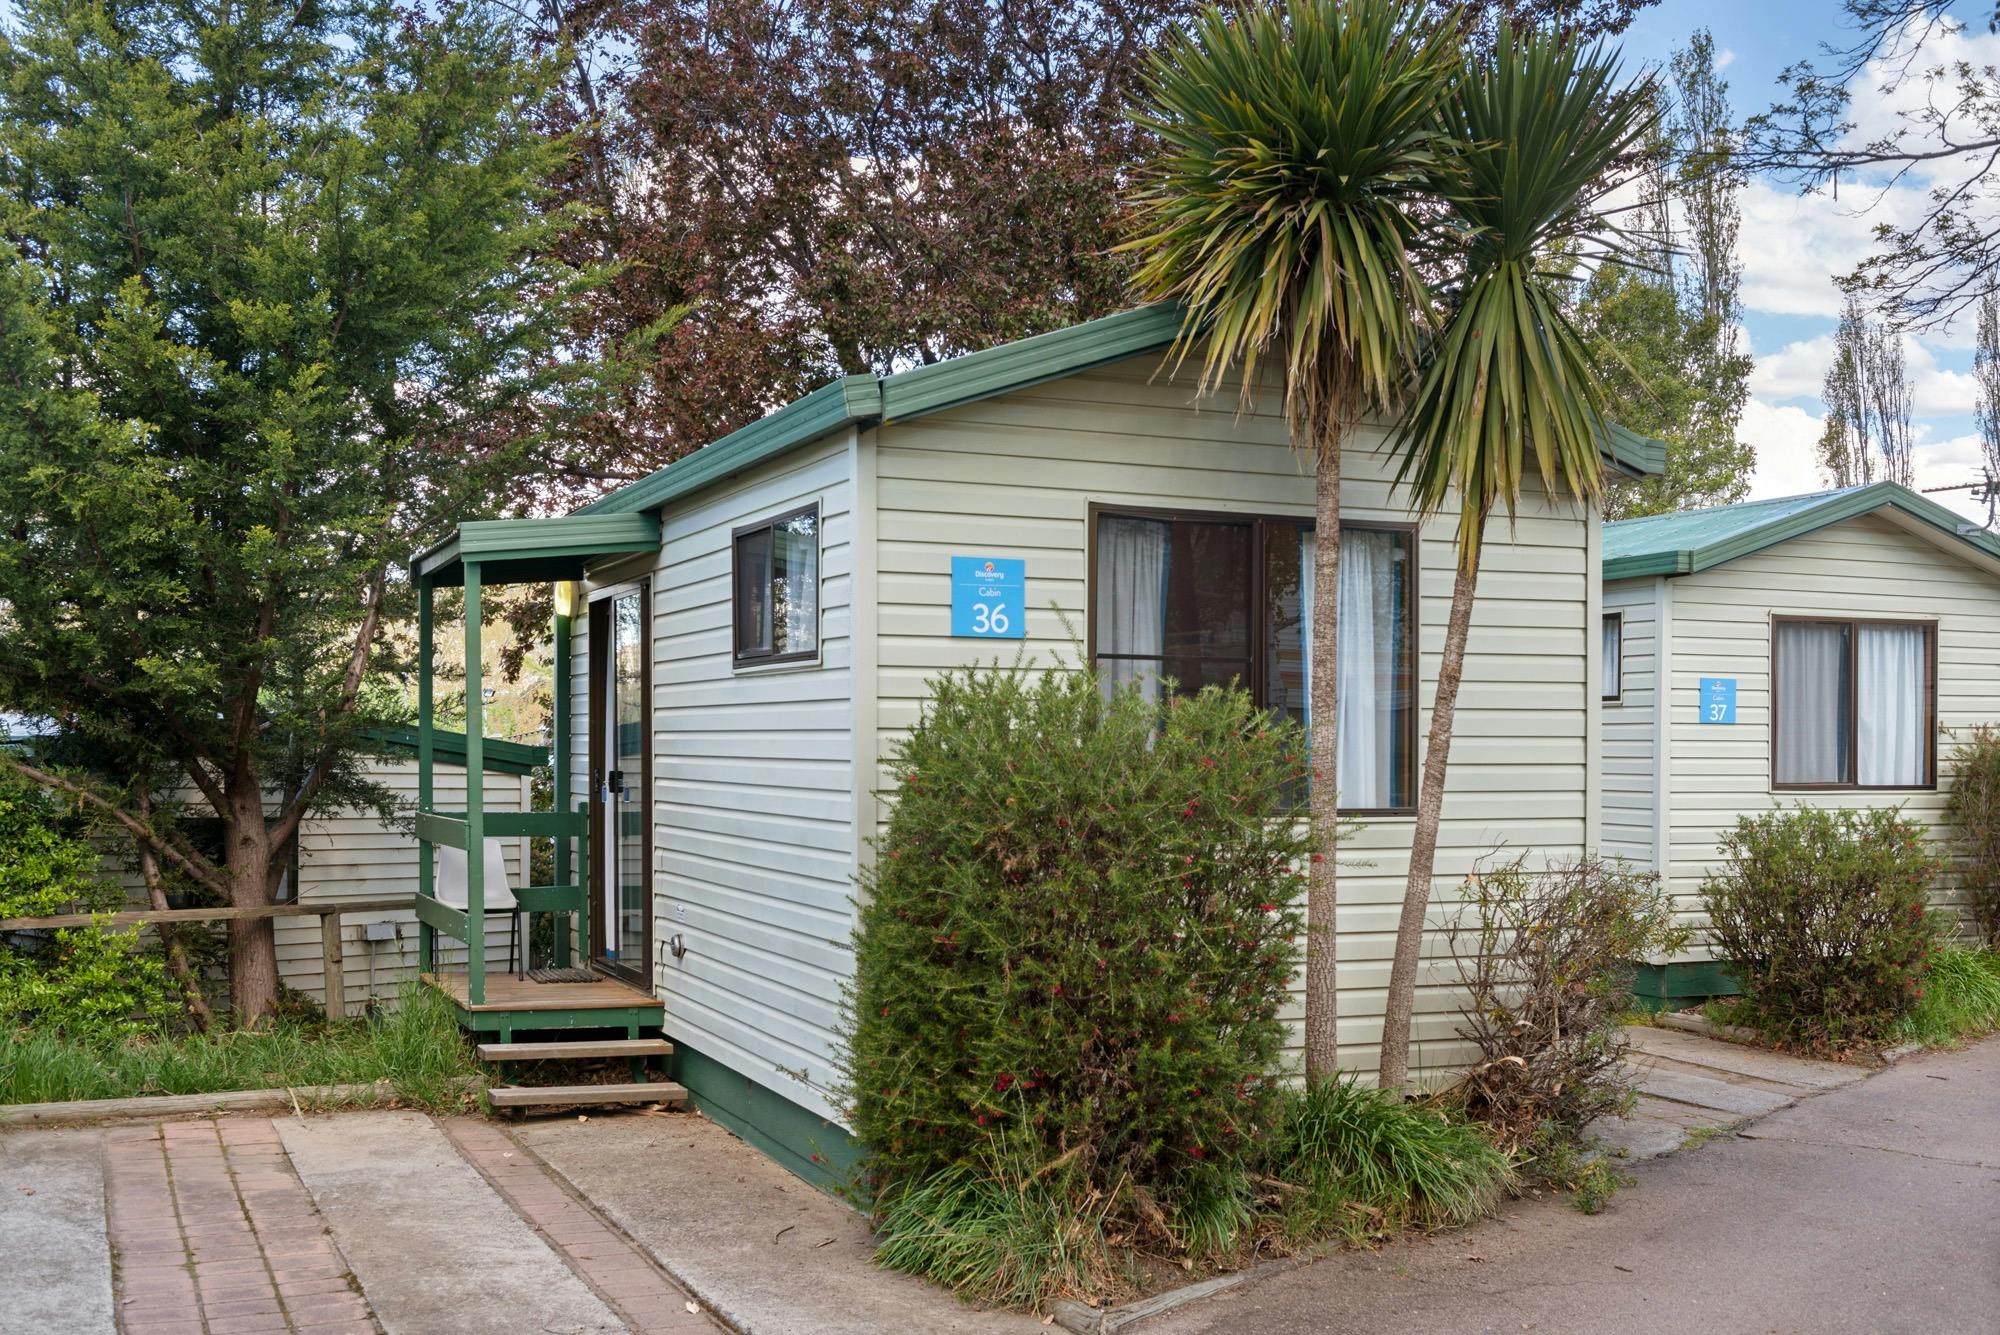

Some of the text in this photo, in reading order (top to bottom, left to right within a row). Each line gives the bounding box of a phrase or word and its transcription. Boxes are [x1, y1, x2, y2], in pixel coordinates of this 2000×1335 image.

[975, 570, 1004, 580] Discovery
[978, 587, 1001, 597] Cabin
[972, 602, 1009, 633] 36
[1710, 704, 1727, 720] 37
